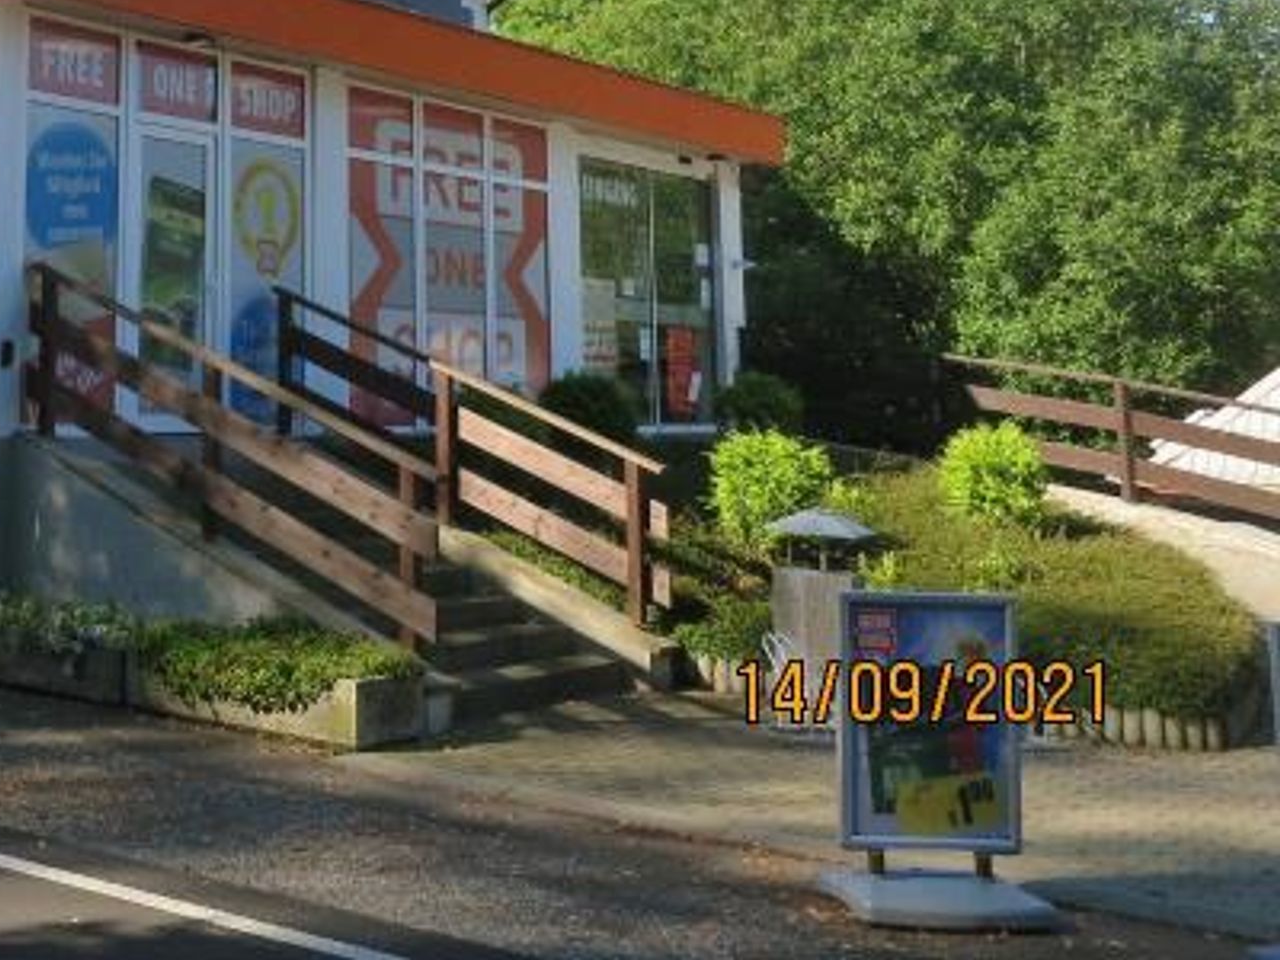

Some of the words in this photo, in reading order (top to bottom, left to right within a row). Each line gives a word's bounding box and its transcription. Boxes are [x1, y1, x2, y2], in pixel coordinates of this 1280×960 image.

[40, 42, 105, 89] FREE
[153, 63, 198, 106] ONE
[238, 74, 297, 120] SHOP
[390, 138, 513, 219] FREE
